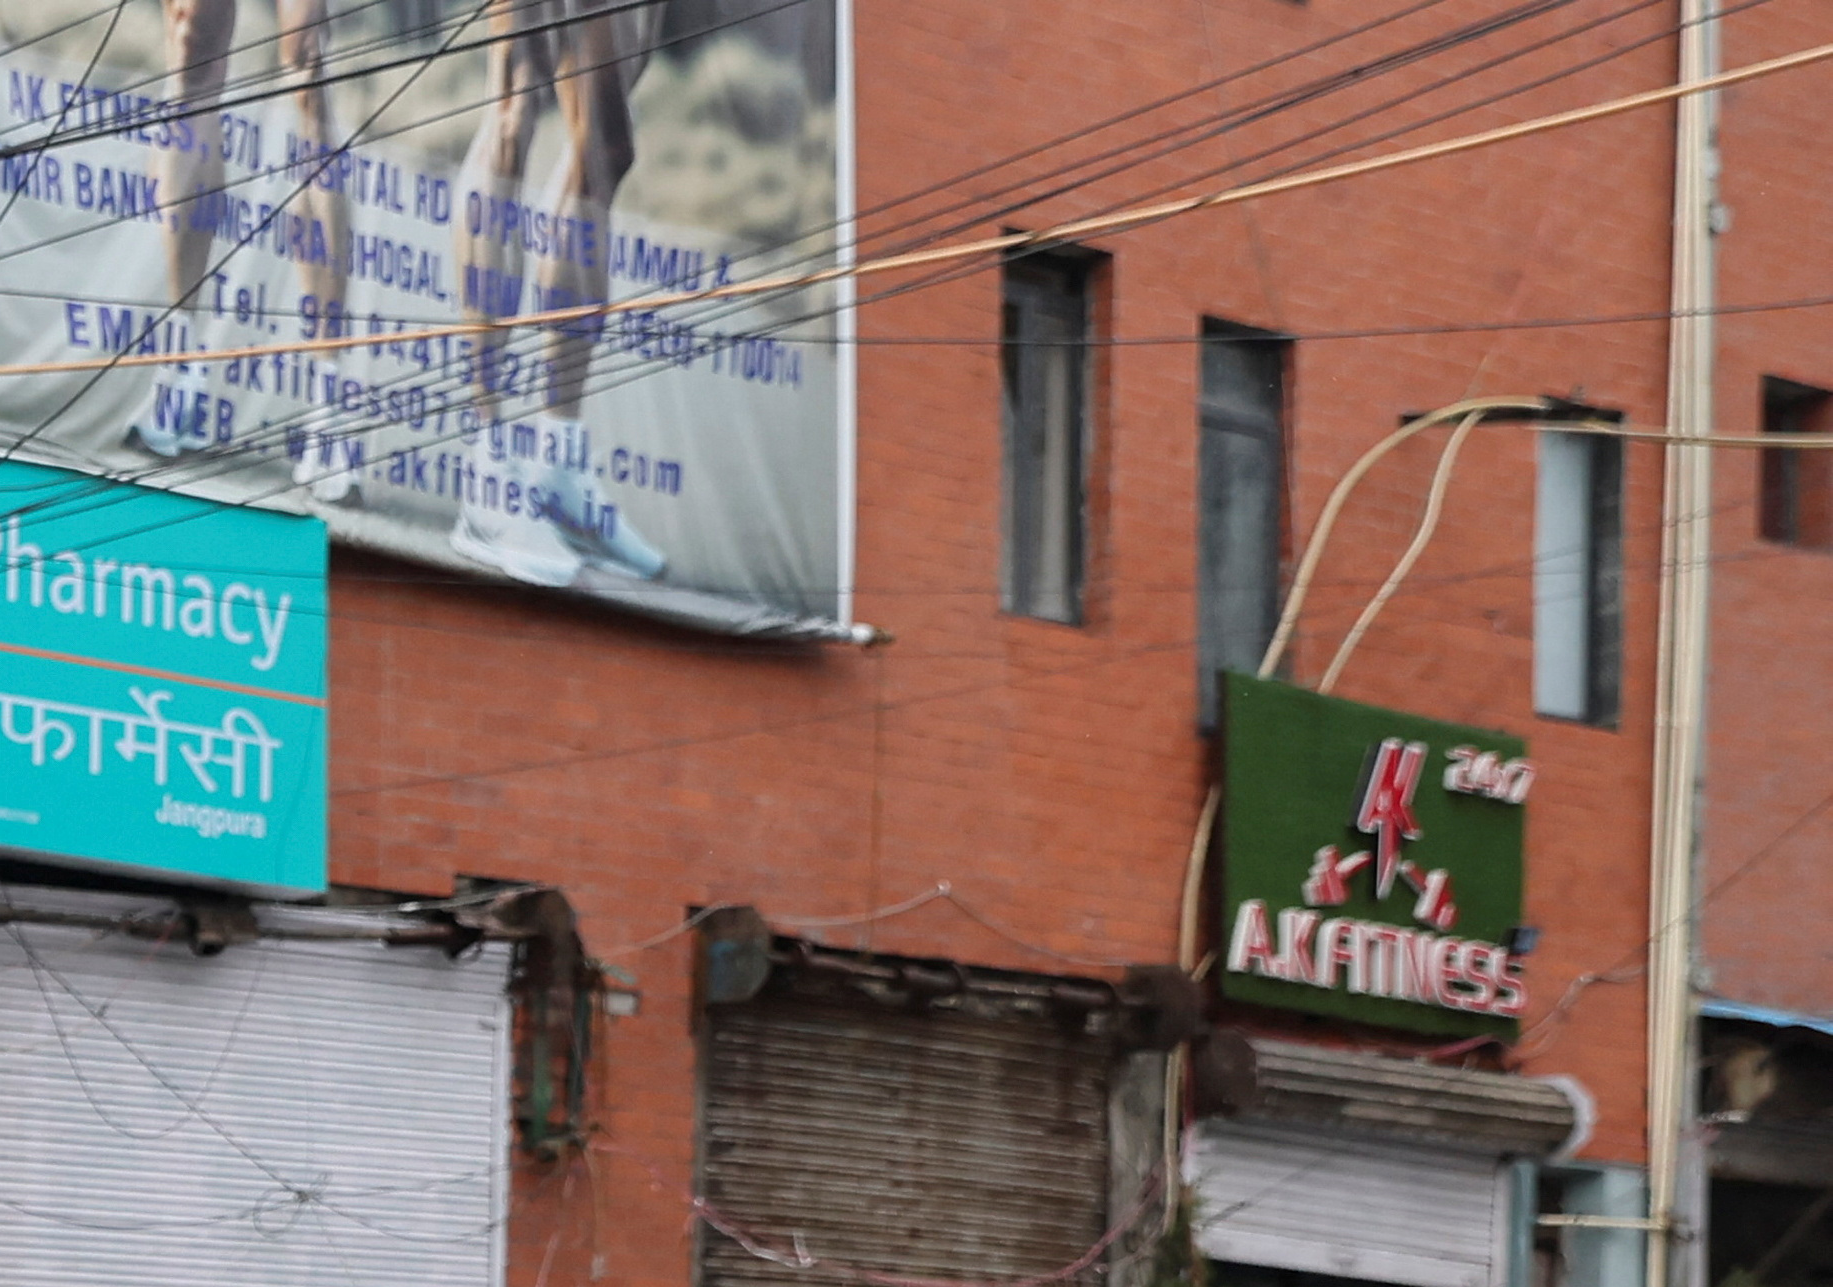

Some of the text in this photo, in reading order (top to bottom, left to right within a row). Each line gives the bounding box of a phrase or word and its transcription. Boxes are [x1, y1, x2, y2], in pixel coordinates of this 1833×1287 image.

[8, 70, 45, 124] AK
[284, 132, 404, 213] HOSPITAL
[415, 172, 451, 225] RD
[467, 190, 596, 267] OPPOSITE
[212, 271, 278, 334] Tel.
[154, 793, 269, 841] Jangpura
